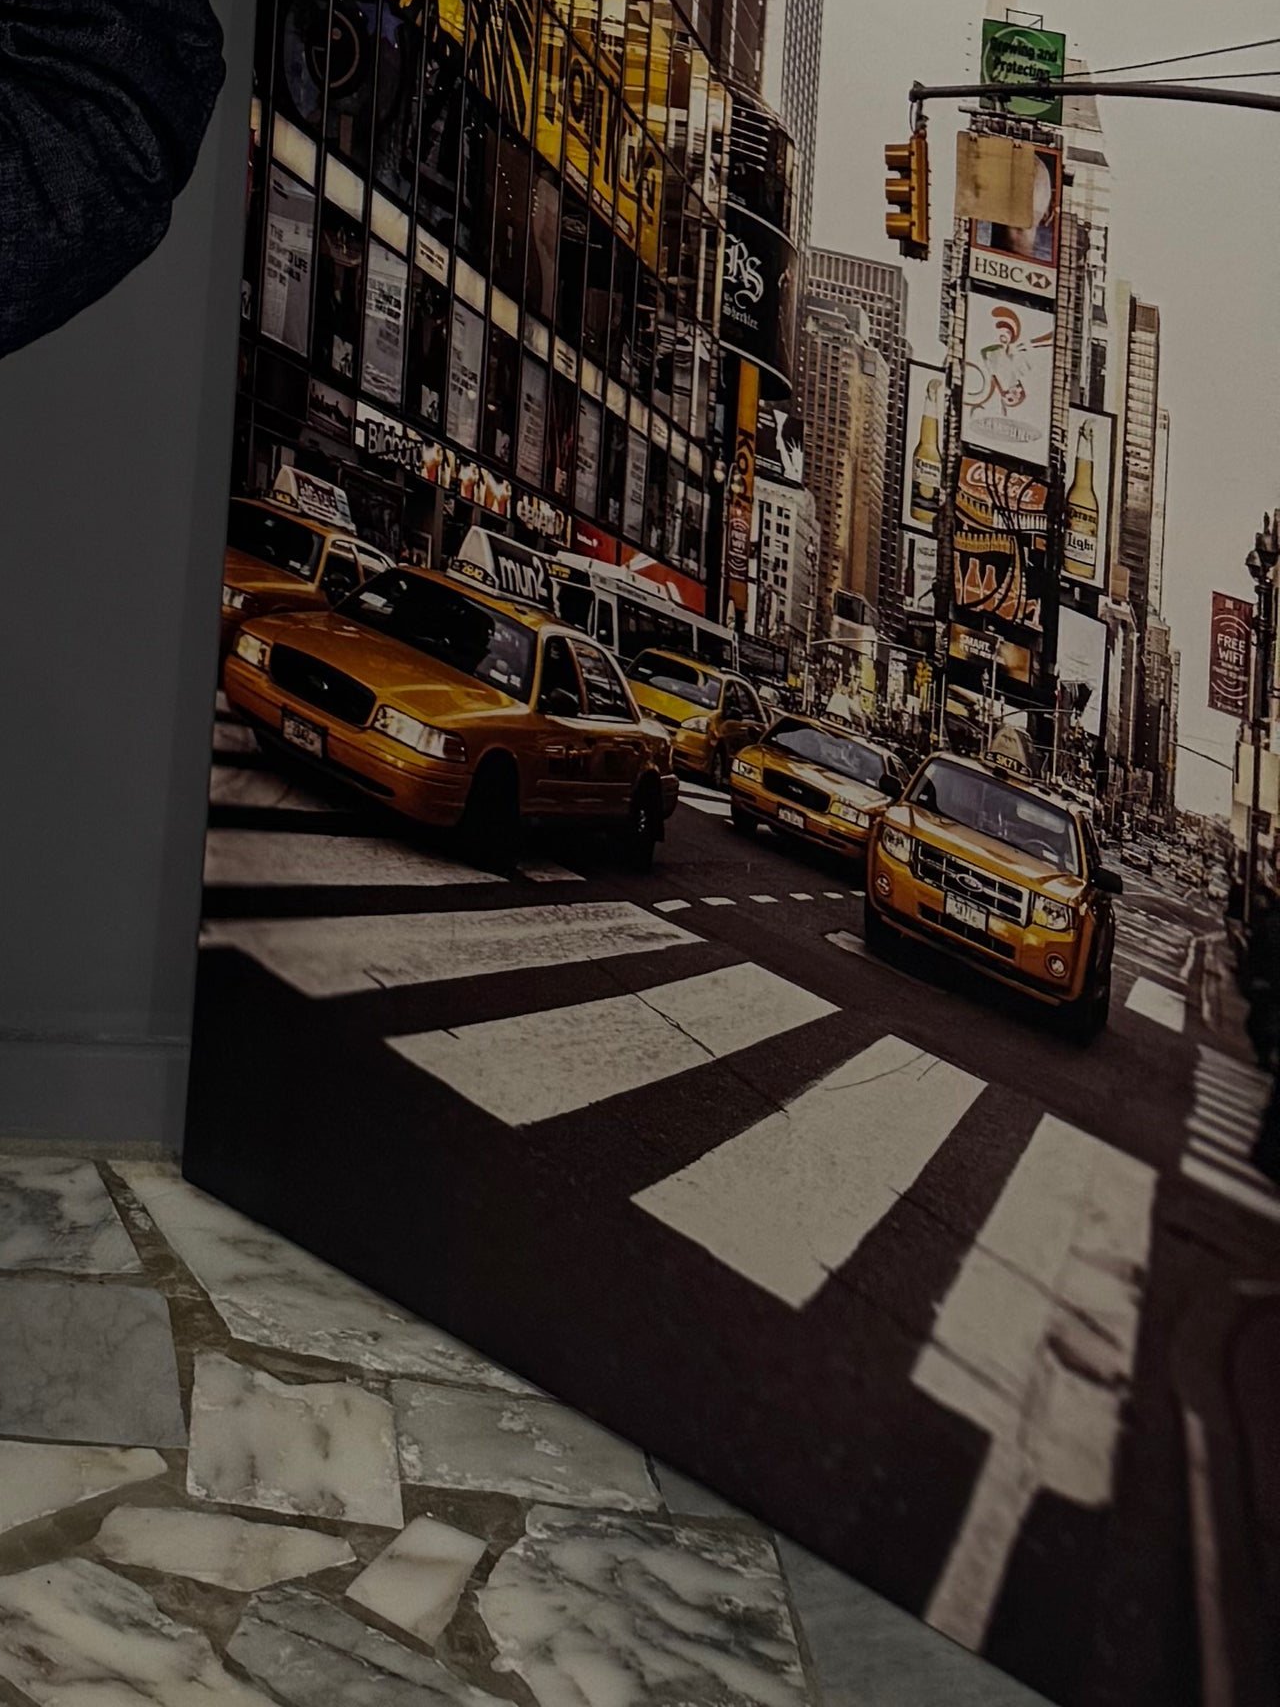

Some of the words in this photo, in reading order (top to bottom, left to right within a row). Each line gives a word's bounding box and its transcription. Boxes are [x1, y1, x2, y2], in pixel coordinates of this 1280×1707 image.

[974, 255, 1024, 284] HSBC
[498, 555, 550, 601] mun2
[1216, 632, 1247, 654] FREE
